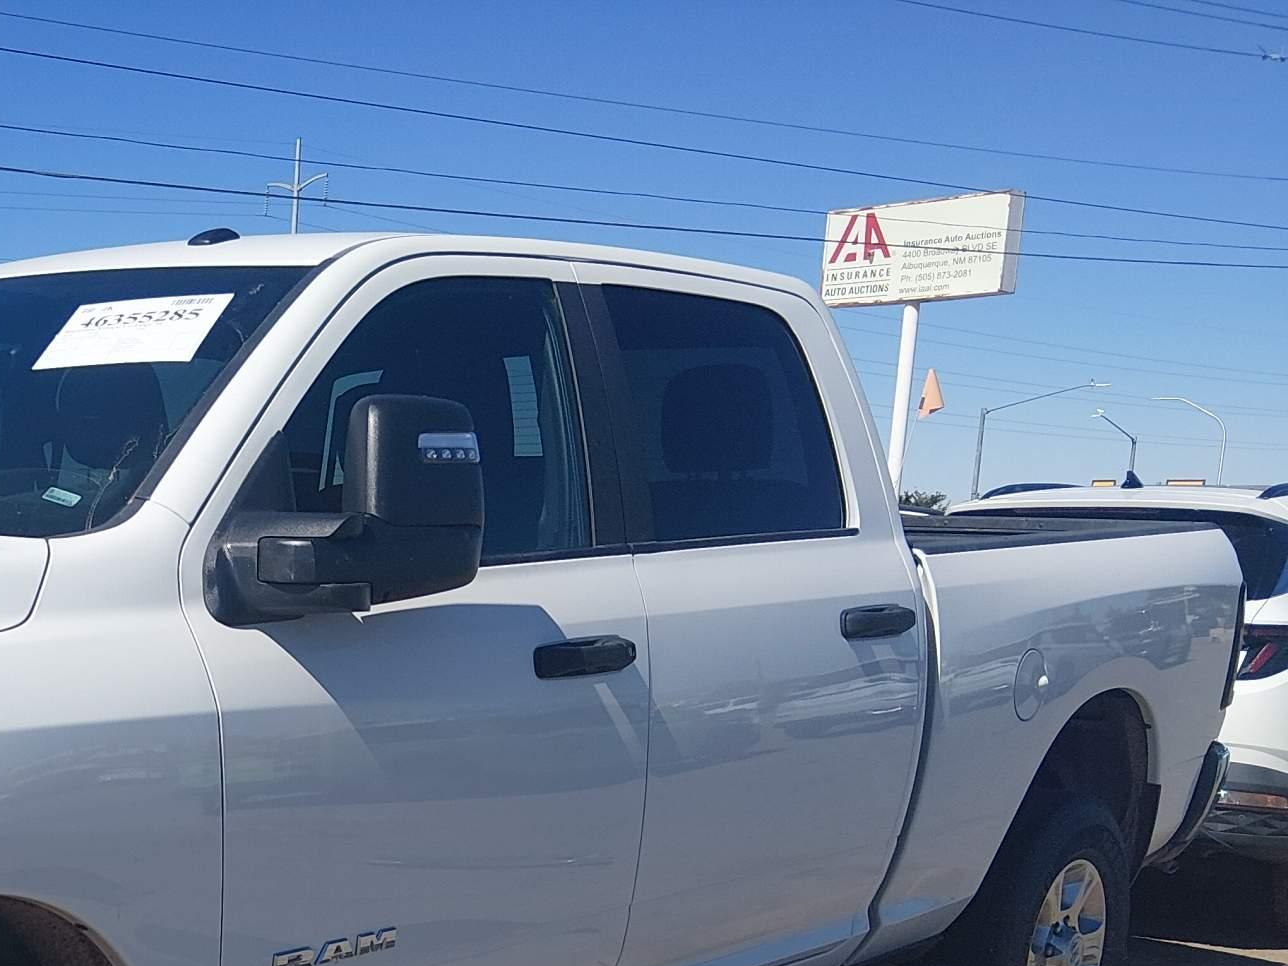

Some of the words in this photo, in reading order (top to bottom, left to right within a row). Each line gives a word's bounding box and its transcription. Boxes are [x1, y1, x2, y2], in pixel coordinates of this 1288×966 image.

[903, 238, 943, 248] Insurance
[944, 234, 963, 244] Auto
[964, 231, 1002, 242] Auctions
[902, 249, 922, 259] 4400
[985, 241, 998, 250] SE
[952, 256, 966, 265] NM
[968, 254, 992, 264] 87105
[826, 267, 891, 282] INSURANCE
[914, 271, 935, 284] (505)
[936, 269, 972, 280] 873-2081
[824, 287, 847, 297] AUTO
[848, 283, 889, 295] AUCTIONS
[80, 308, 205, 328] 46355285
